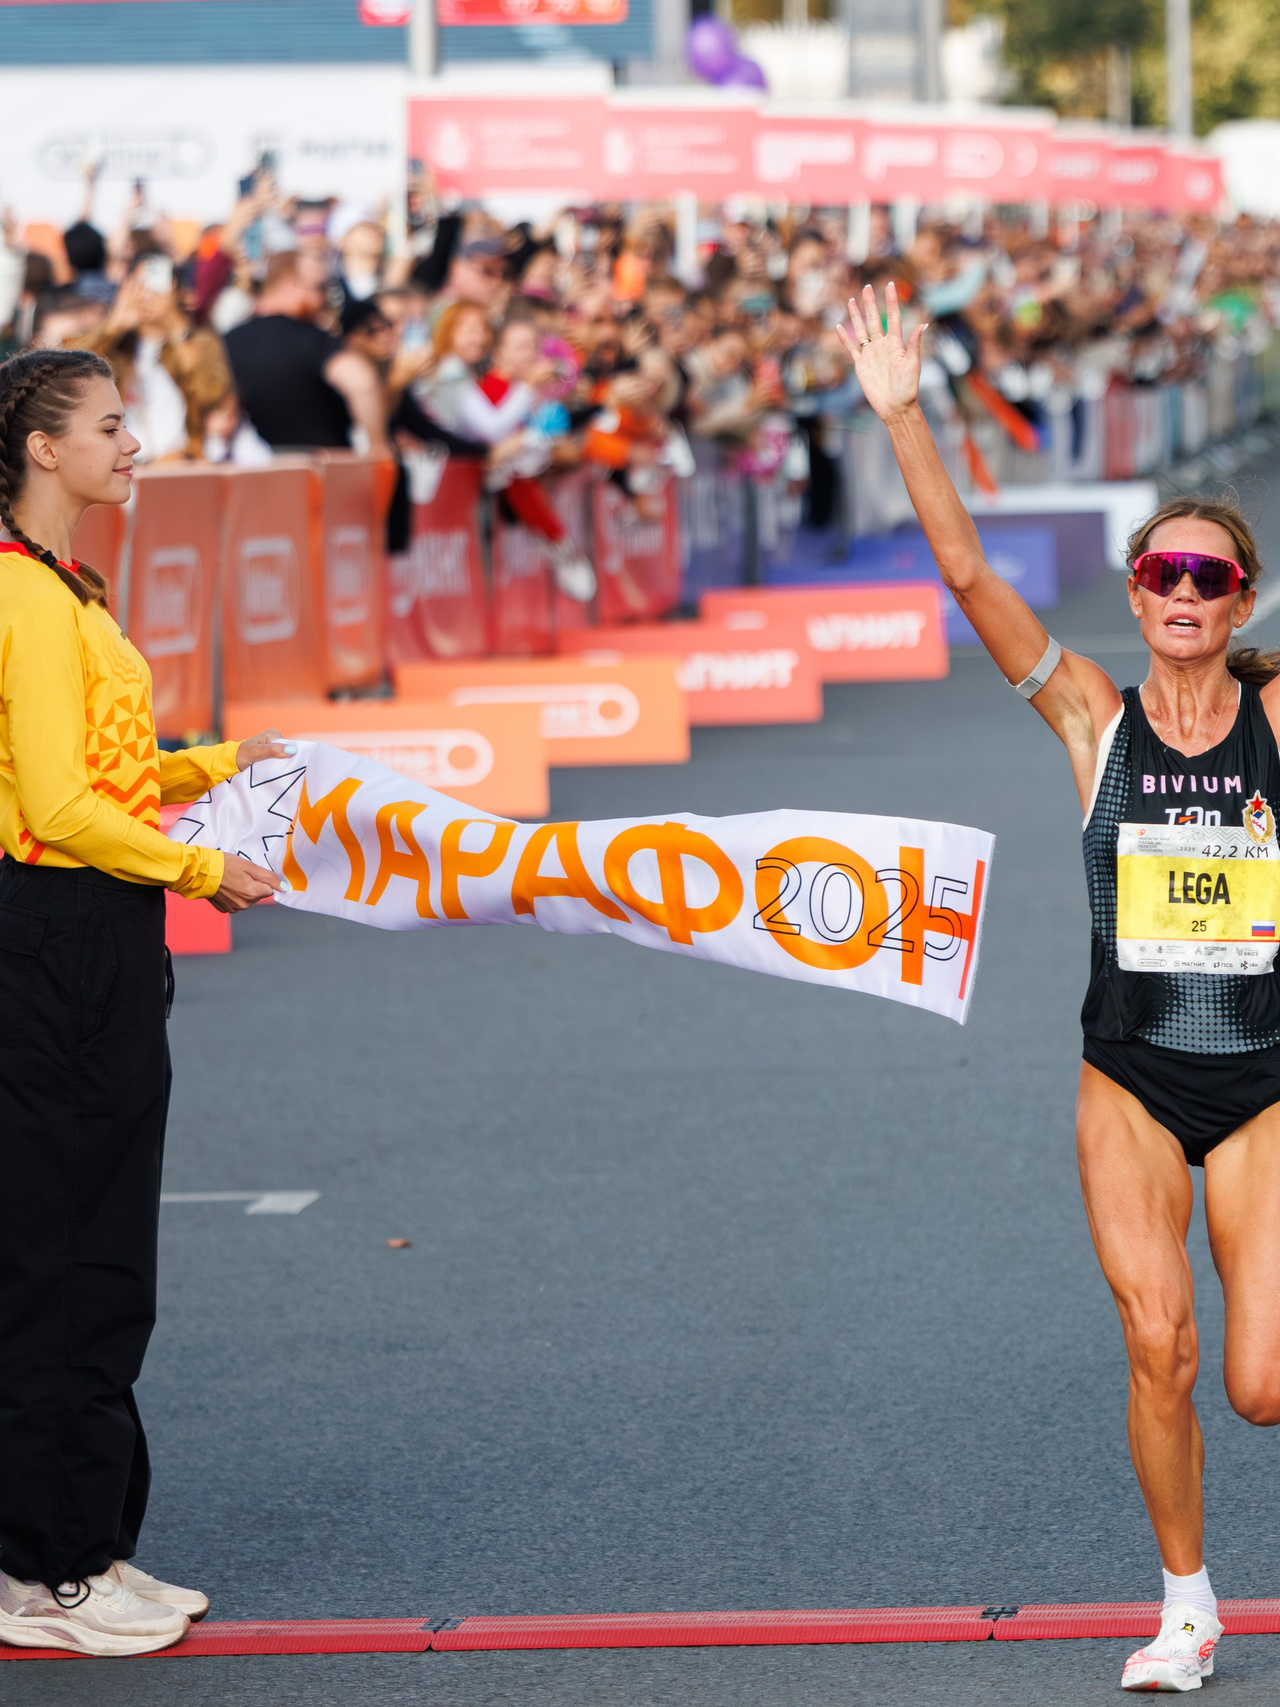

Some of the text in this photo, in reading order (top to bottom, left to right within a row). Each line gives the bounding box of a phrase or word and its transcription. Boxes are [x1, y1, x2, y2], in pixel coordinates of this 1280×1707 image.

[1142, 774, 1242, 794] BIVIUM
[1202, 844, 1238, 860] 42,2
[282, 777, 987, 1001] МАРАФОН
[1168, 870, 1231, 905] LEGA
[753, 857, 970, 961] 2025
[1191, 920, 1207, 932] 25
